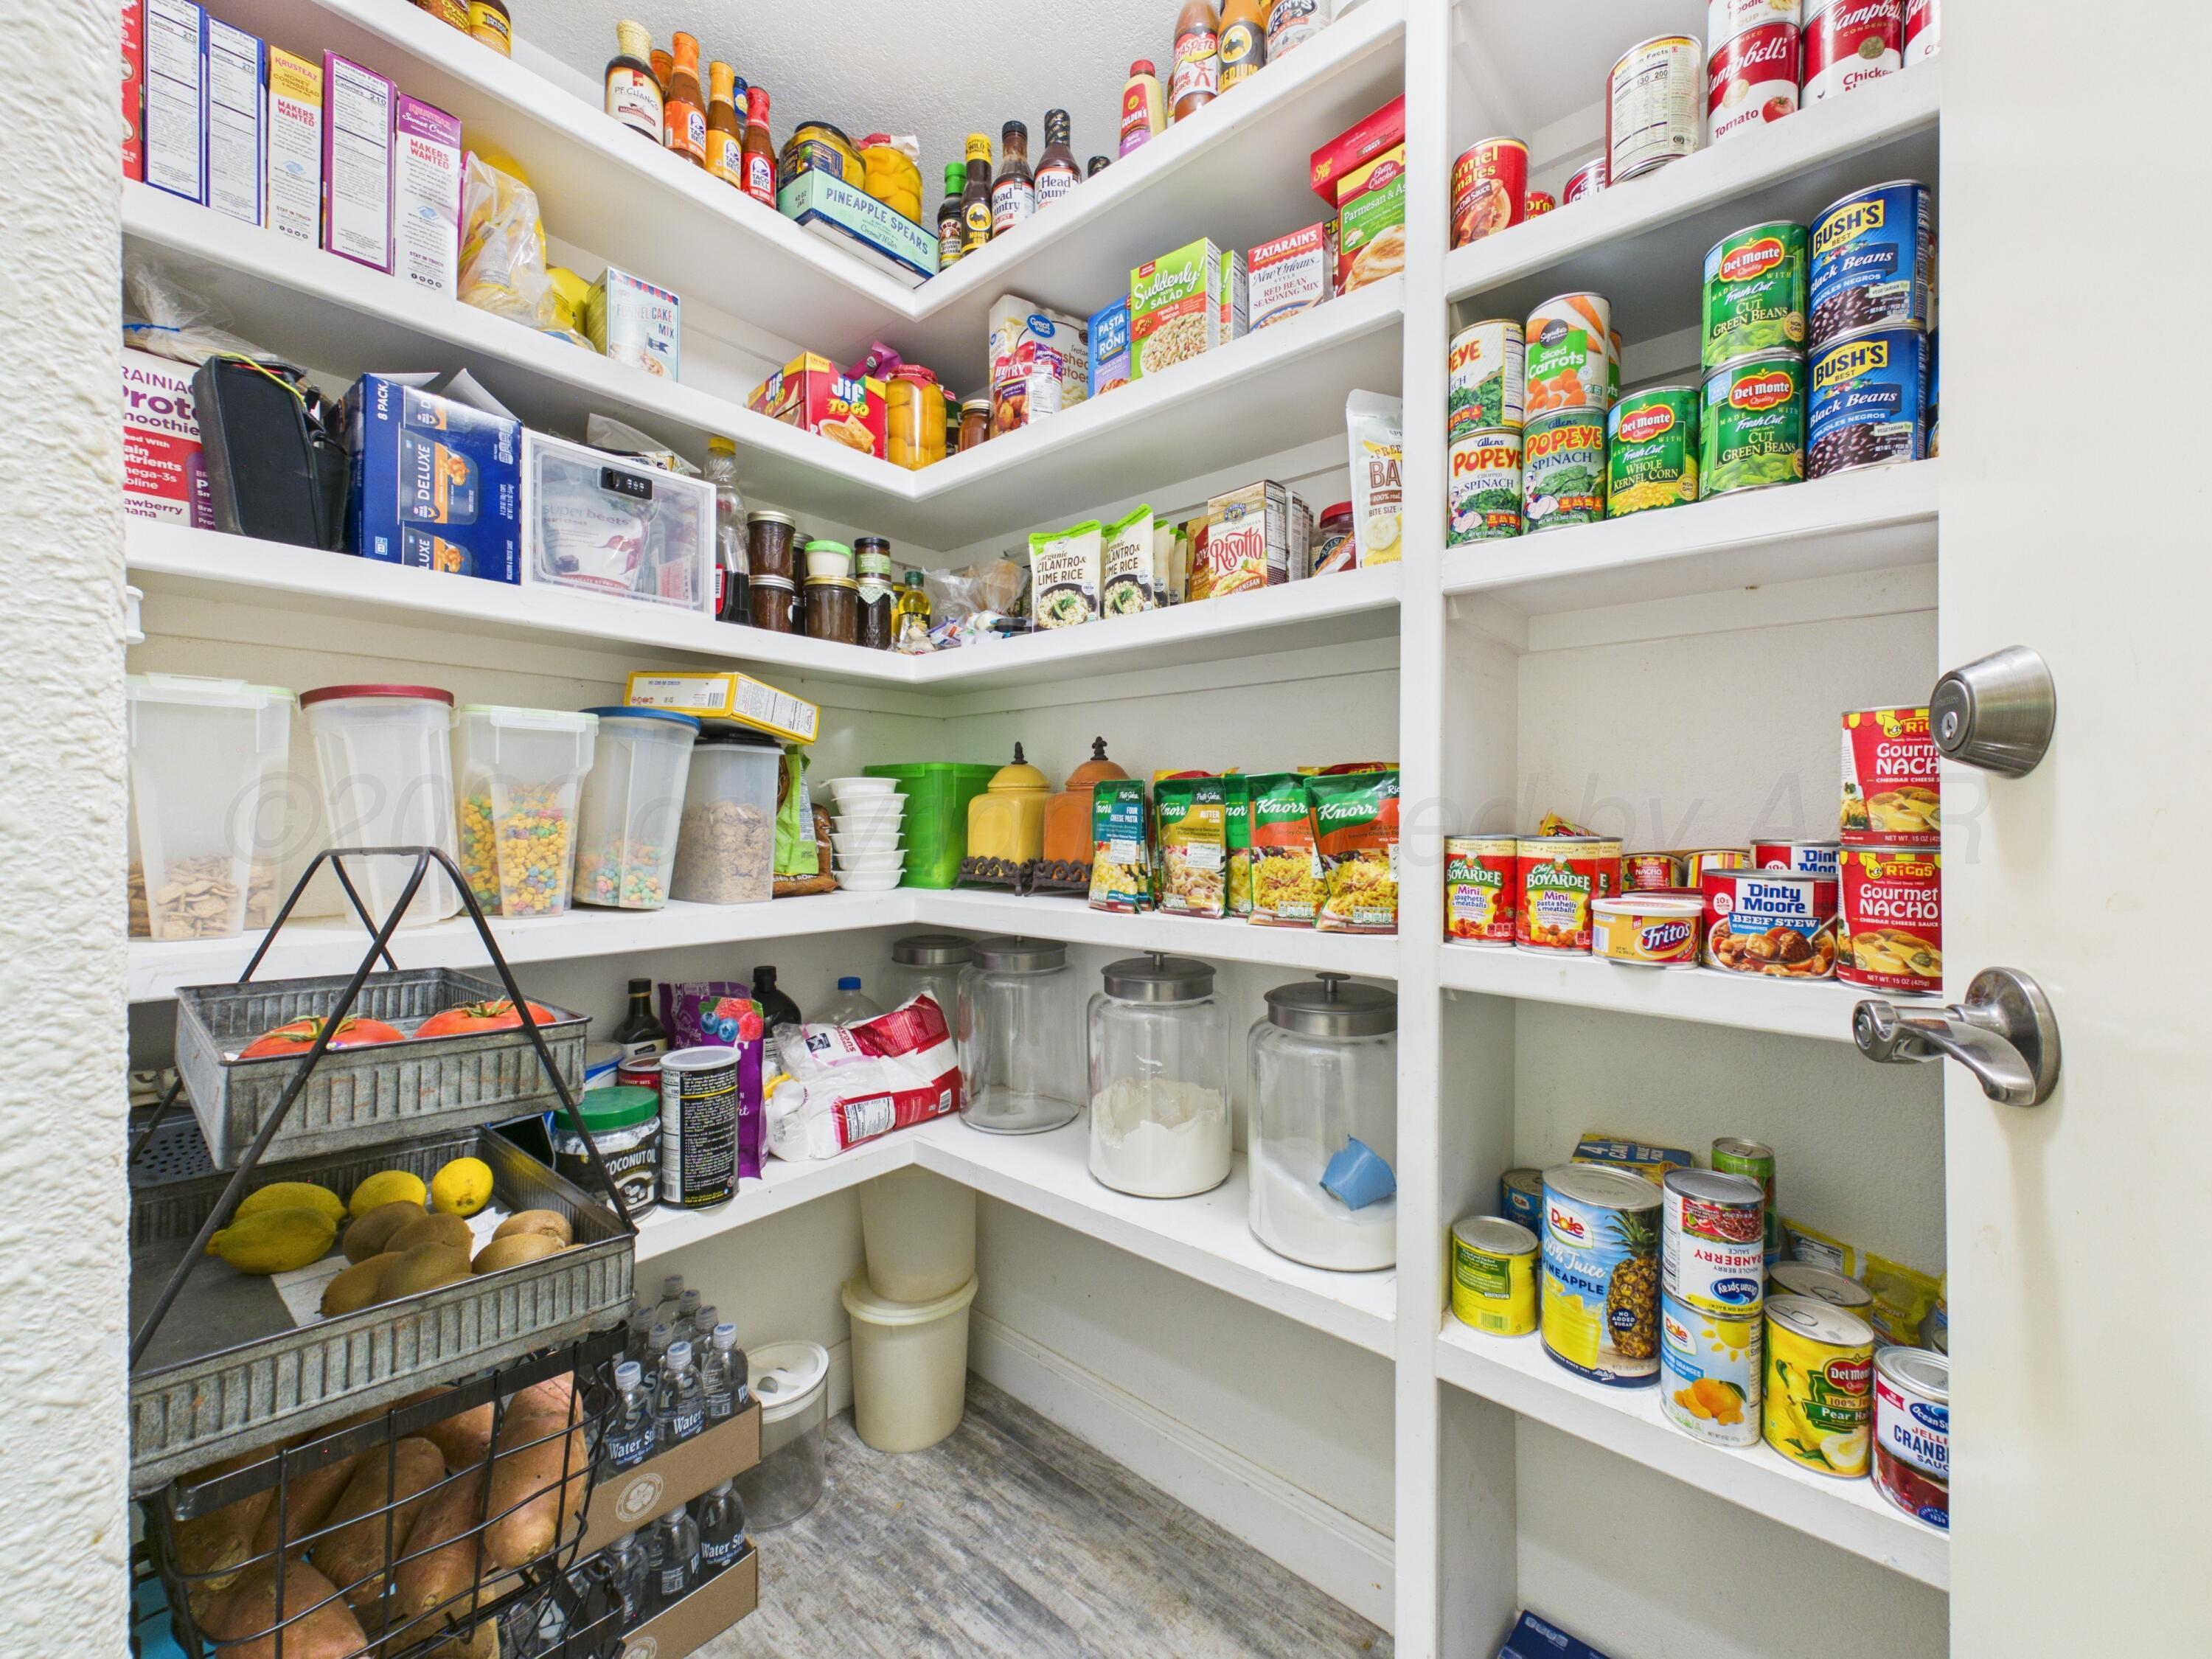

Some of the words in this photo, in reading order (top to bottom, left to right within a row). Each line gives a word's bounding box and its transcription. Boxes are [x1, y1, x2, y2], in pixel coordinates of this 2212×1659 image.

[184, 31, 197, 43] 270
[242, 63, 255, 73] 270
[275, 56, 318, 82] KRUSTEAZ
[1655, 69, 1668, 80] 200
[369, 94, 386, 106] 210
[277, 100, 314, 119] MAKERS
[277, 105, 314, 128] WANTED
[1715, 109, 1759, 139] Tomato
[690, 127, 706, 142] TACO
[691, 134, 705, 148] BELL
[410, 139, 449, 161] MAKERS
[968, 143, 984, 151] WILD
[410, 147, 449, 170] WANTED
[752, 173, 769, 184] TACO
[1374, 163, 1393, 178] Betty
[753, 179, 769, 191] BELL
[1042, 175, 1071, 189] Head
[1369, 170, 1397, 189] Crocker
[1471, 184, 1490, 201] Sauce
[1344, 195, 1385, 223] Parmesan
[1388, 192, 1394, 200] &
[827, 187, 888, 223] PINEAPPLE
[891, 218, 928, 255] SPEARS
[1815, 204, 1881, 254] BUSH'S
[970, 232, 990, 240] HONEY
[1832, 233, 1851, 246] BEST
[1253, 230, 1318, 262] ZATARAIN'S
[1723, 259, 1741, 274] Del
[1742, 248, 1781, 266] Monte
[1841, 251, 1894, 271] Beans
[1133, 256, 1205, 310] Suddenly!
[1253, 269, 1276, 287] New
[1274, 274, 1295, 283] STYLE
[1843, 274, 1882, 287] NEGROS
[1253, 288, 1300, 308] SEASONING
[1302, 282, 1319, 293] MIX
[1264, 283, 1281, 297] RED
[1284, 277, 1307, 293] BEAN
[1150, 289, 1183, 310] SALAD
[1736, 299, 1763, 316] CUT
[652, 307, 672, 322] CAKE
[1713, 312, 1748, 337] GREEN
[1751, 306, 1788, 323] BEANS
[658, 323, 675, 339] MIX
[1029, 318, 1051, 330] Great
[1098, 313, 1125, 337] PASTA
[1099, 330, 1125, 357] RONI
[1540, 347, 1566, 361] Sliced
[1529, 355, 1584, 378] Carrots
[1815, 344, 1886, 386] BUSH'S
[1834, 370, 1855, 381] BEST
[831, 378, 864, 402] Jif
[1733, 386, 1753, 399] Del
[1755, 382, 1790, 394] Monte
[828, 399, 849, 414] TO
[851, 401, 869, 417] GO
[1750, 395, 1775, 405] Quality
[378, 411, 388, 420] 8
[1810, 400, 1843, 429] Black
[1846, 392, 1897, 408] Beans
[1848, 412, 1886, 423] NEGROS
[1622, 422, 1636, 434] Del
[1638, 413, 1671, 428] Monte
[1735, 417, 1764, 433] Fresh
[1763, 414, 1787, 425] Cut
[145, 437, 170, 448] With
[1477, 438, 1504, 447] Allens
[1526, 426, 1602, 462] POPEYE
[1748, 431, 1775, 444] CUT
[1722, 444, 1761, 462] GREEN
[1764, 441, 1796, 454] BEANS
[1454, 449, 1522, 476] POPEYE
[1532, 452, 1592, 472] SPINACH
[1625, 459, 1663, 476] WHOLE
[417, 444, 431, 501] DELUXE
[1613, 473, 1646, 492] KERNEL
[1649, 467, 1679, 481] CORN
[1464, 479, 1514, 491] SPINACH
[1369, 509, 1381, 517] BITE
[1383, 506, 1397, 514] SIZE
[1037, 556, 1079, 574] CILANTRO
[1120, 557, 1138, 571] RICE
[1038, 571, 1058, 586] LIME
[1062, 568, 1083, 580] RICE
[1126, 807, 1138, 815] FOUR
[1256, 799, 1308, 814] Knorr
[1318, 804, 1377, 821] Knorr
[1124, 815, 1138, 824] PASTA
[1532, 864, 1551, 874] Chef
[1447, 870, 1502, 886] BOYARDEE
[1526, 874, 1590, 891] BOYARDEE
[1458, 885, 1480, 895] Mini
[1544, 891, 1568, 901] Mini
[1748, 883, 1801, 902] Dinty
[1860, 883, 1938, 901] Gourmet
[1454, 895, 1485, 904] spaghetti
[1455, 900, 1487, 909] meatballs
[1537, 900, 1555, 909] pasta
[1557, 900, 1576, 908] shells
[1742, 897, 1806, 914] Moore
[1542, 905, 1576, 914] meatballs
[1860, 899, 1938, 919] NACHO
[1733, 914, 1773, 925] BEEF
[1775, 918, 1818, 928] STEW
[1641, 922, 1691, 951] Fritos
[647, 1149, 656, 1164] OIL
[1579, 1146, 1608, 1155] 4
[1609, 1144, 1628, 1159] CAN
[1551, 1208, 1585, 1236] Dole
[1564, 1254, 1606, 1279] Juice
[1713, 1265, 1737, 1273] BERRY
[1542, 1256, 1604, 1295] PINEAPPLE
[1718, 1283, 1739, 1294] Spray
[1740, 1284, 1758, 1295] Ocean
[1666, 1317, 1688, 1340] Dole
[1831, 1368, 1849, 1380] Del
[1830, 1398, 1855, 1407] 100%
[1822, 1407, 1851, 1420] Pear
[1912, 1406, 1938, 1427] Ocean
[673, 1411, 702, 1435] Water
[610, 1438, 641, 1460] Water
[701, 1541, 731, 1559] Water
